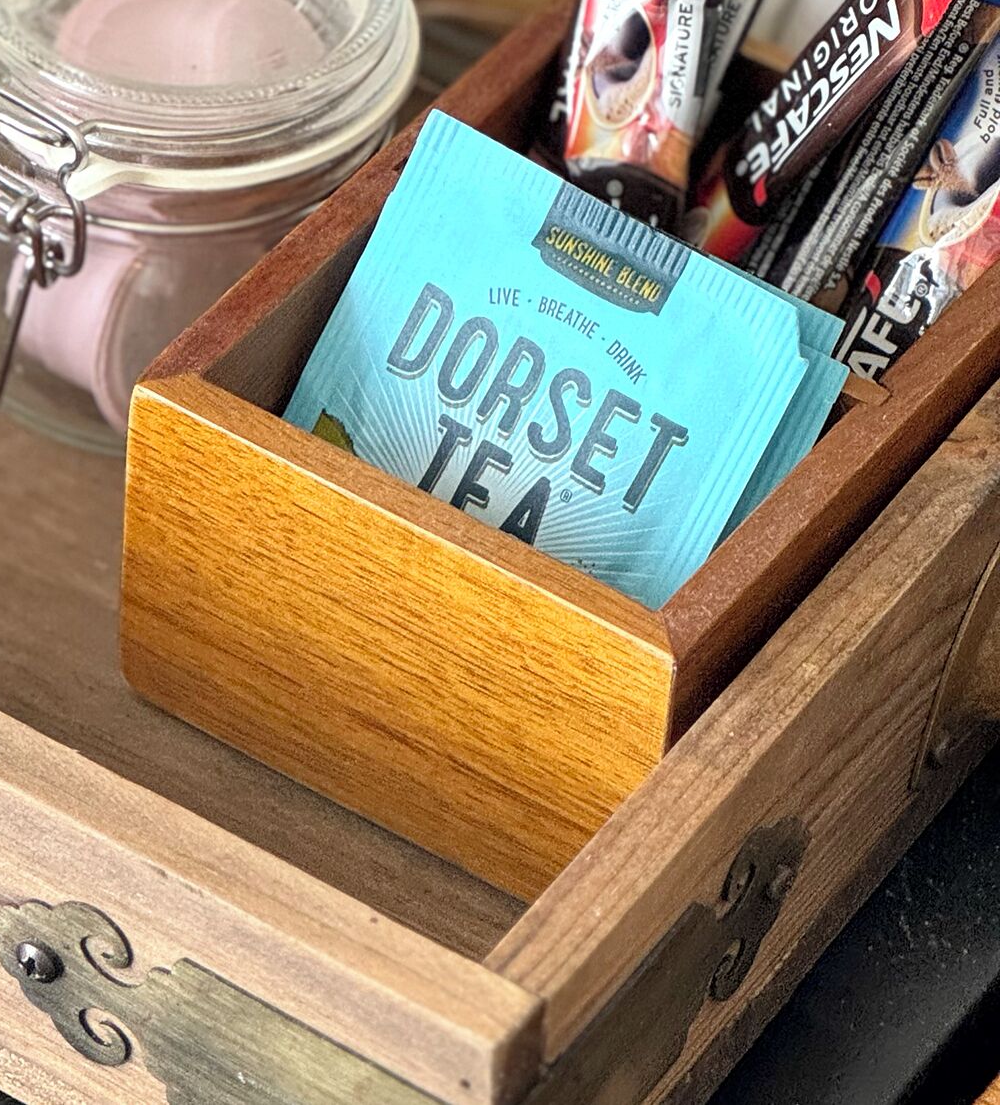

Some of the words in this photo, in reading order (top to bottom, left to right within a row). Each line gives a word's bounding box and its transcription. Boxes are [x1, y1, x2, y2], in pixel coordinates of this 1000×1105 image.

[942, 17, 969, 51] Before
[668, 2, 695, 109] SIGNATURE
[910, 49, 935, 83] minste
[940, 51, 964, 77] Reg.
[884, 80, 918, 127] houdbaar
[900, 46, 951, 122] End/Mindestens
[914, 75, 951, 130] Trademark
[973, 98, 991, 129] Full
[983, 68, 995, 96] and
[859, 119, 882, 148] entro
[876, 124, 892, 142] tot
[907, 126, 923, 143] of
[980, 107, 1000, 144] bold
[874, 150, 891, 169] bis
[875, 176, 895, 199] des
[852, 195, 884, 241] Produits
[545, 226, 615, 277] SUNSHINE
[616, 265, 663, 303] BLEND
[488, 286, 521, 308] LIVE
[537, 295, 601, 340] BREATHE
[605, 338, 648, 386] DRINK
[385, 281, 690, 515] DORSET
